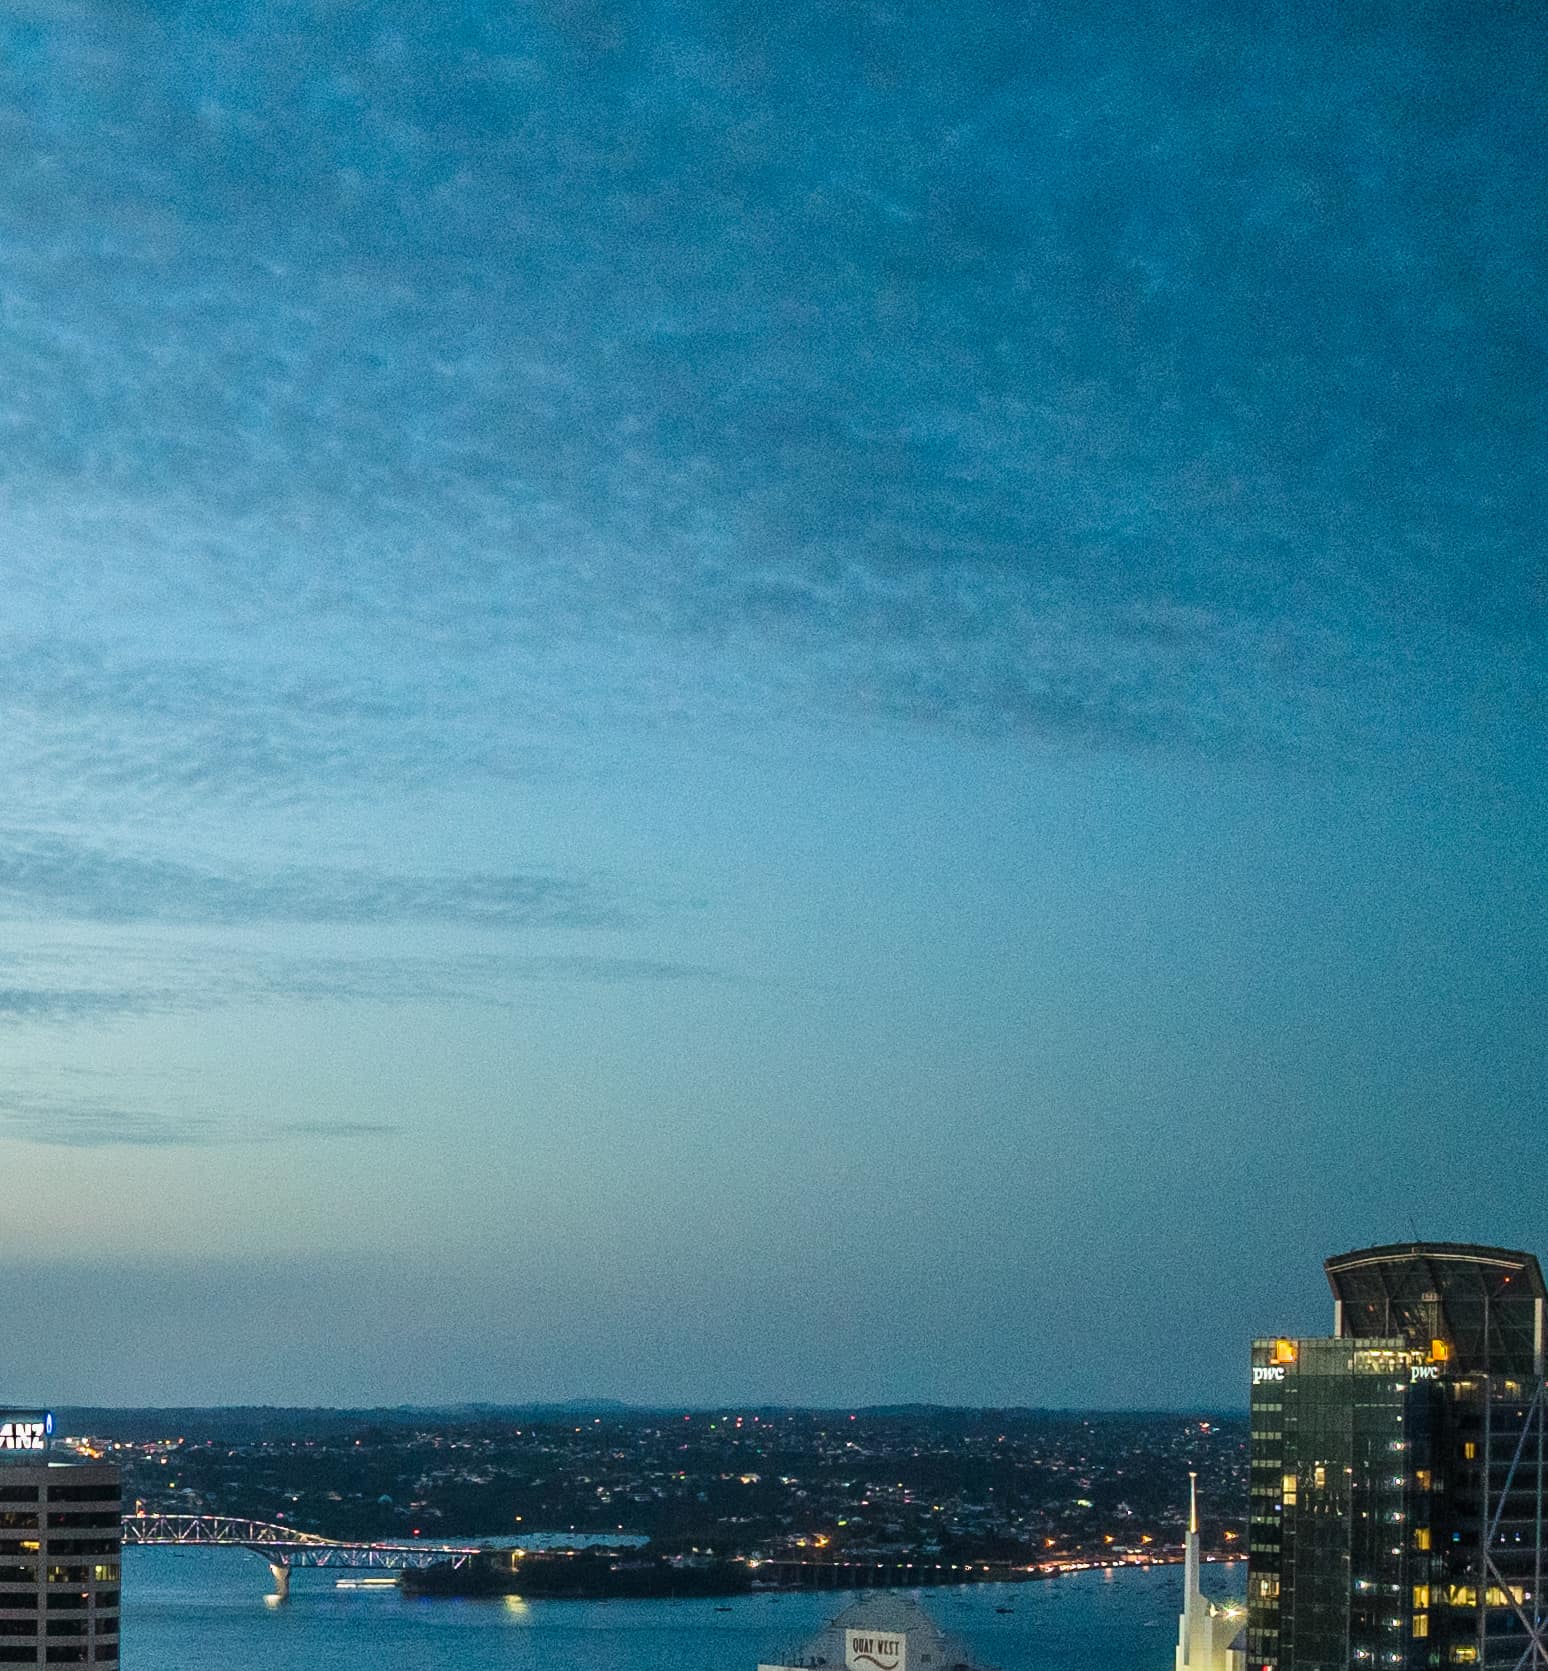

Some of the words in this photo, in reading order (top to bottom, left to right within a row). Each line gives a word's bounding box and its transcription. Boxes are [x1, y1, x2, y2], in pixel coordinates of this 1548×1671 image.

[1253, 1366, 1285, 1385] pwc
[1410, 1366, 1440, 1384] pwc
[853, 1638, 873, 1654] QUAY
[878, 1639, 899, 1656] WEST
